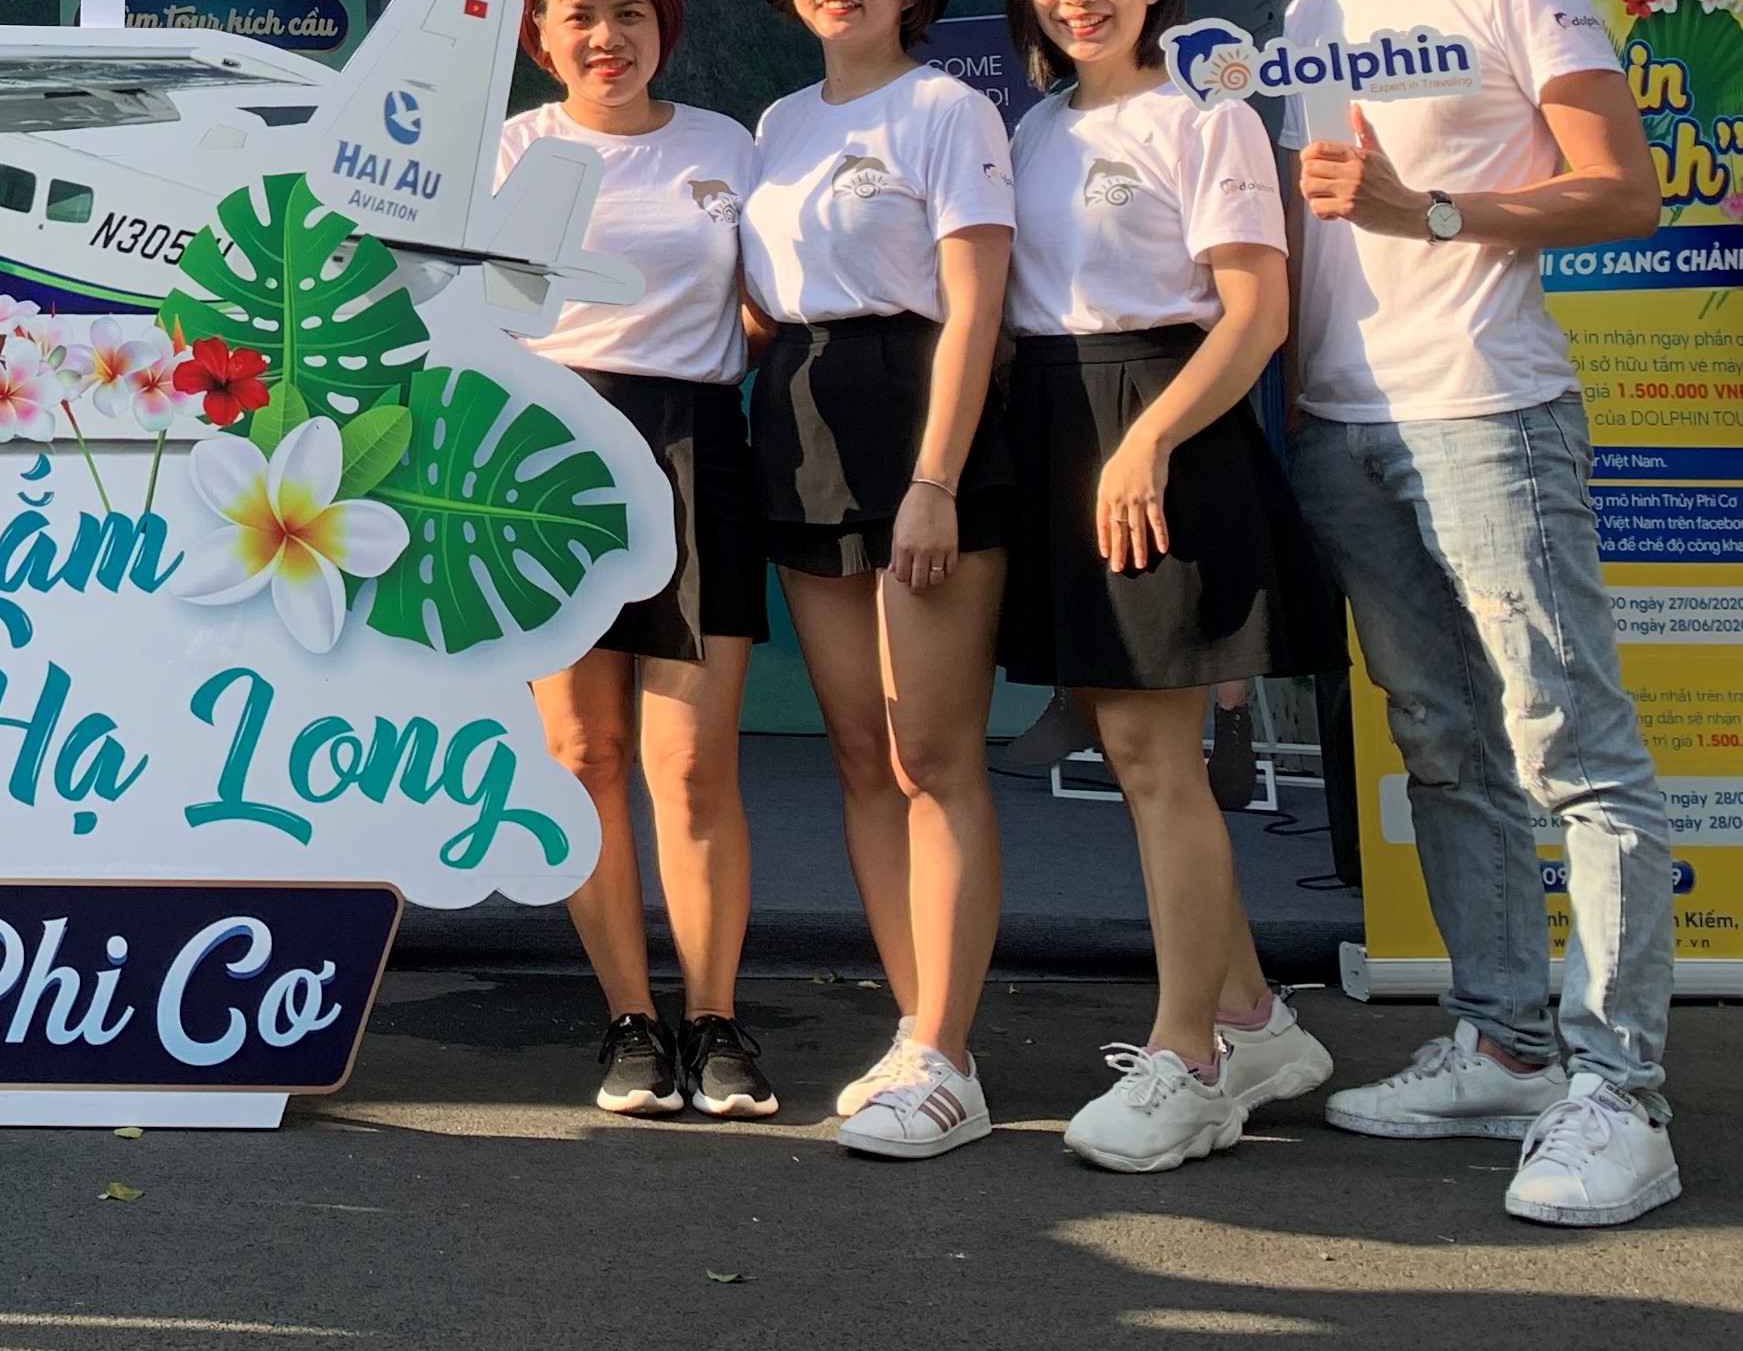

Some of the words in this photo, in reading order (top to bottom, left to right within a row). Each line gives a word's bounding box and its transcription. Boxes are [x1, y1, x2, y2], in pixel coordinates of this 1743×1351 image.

[227, 6, 285, 36] kích
[287, 3, 339, 37] cầu
[1259, 34, 1470, 91] dolphin
[1370, 82, 1406, 94] Expert
[1409, 81, 1420, 90] in
[1422, 76, 1473, 89] Traveling
[332, 140, 390, 189] HAI
[394, 159, 442, 201] AU
[348, 189, 419, 223] AVIATION
[1559, 252, 1598, 276] CƠ
[1602, 250, 1671, 274] SANG
[1676, 241, 1743, 273] CHẢN
[1584, 329, 1599, 345] in
[1604, 329, 1645, 350] nhận
[1651, 334, 1690, 350] ngay
[1618, 383, 1708, 399] 1.500.000
[1595, 409, 1626, 426] của
[1631, 410, 1709, 427] DOLPHIN
[1602, 454, 1629, 471] Việt
[1606, 493, 1630, 508] mô
[1631, 493, 1660, 508] hình
[1696, 493, 1716, 508] Phi
[1718, 494, 1738, 508] Cơ
[1603, 515, 1630, 532] Việt
[1633, 516, 1666, 530] Nam
[1667, 515, 1695, 530] trên
[1687, 537, 1720, 556] công
[1630, 596, 1664, 614] ngày
[1630, 618, 1666, 636] ngày
[1697, 690, 1724, 703] trên
[184, 667, 570, 869] Long
[1671, 791, 1707, 808] ngày
[156, 914, 342, 1066] Cơ
